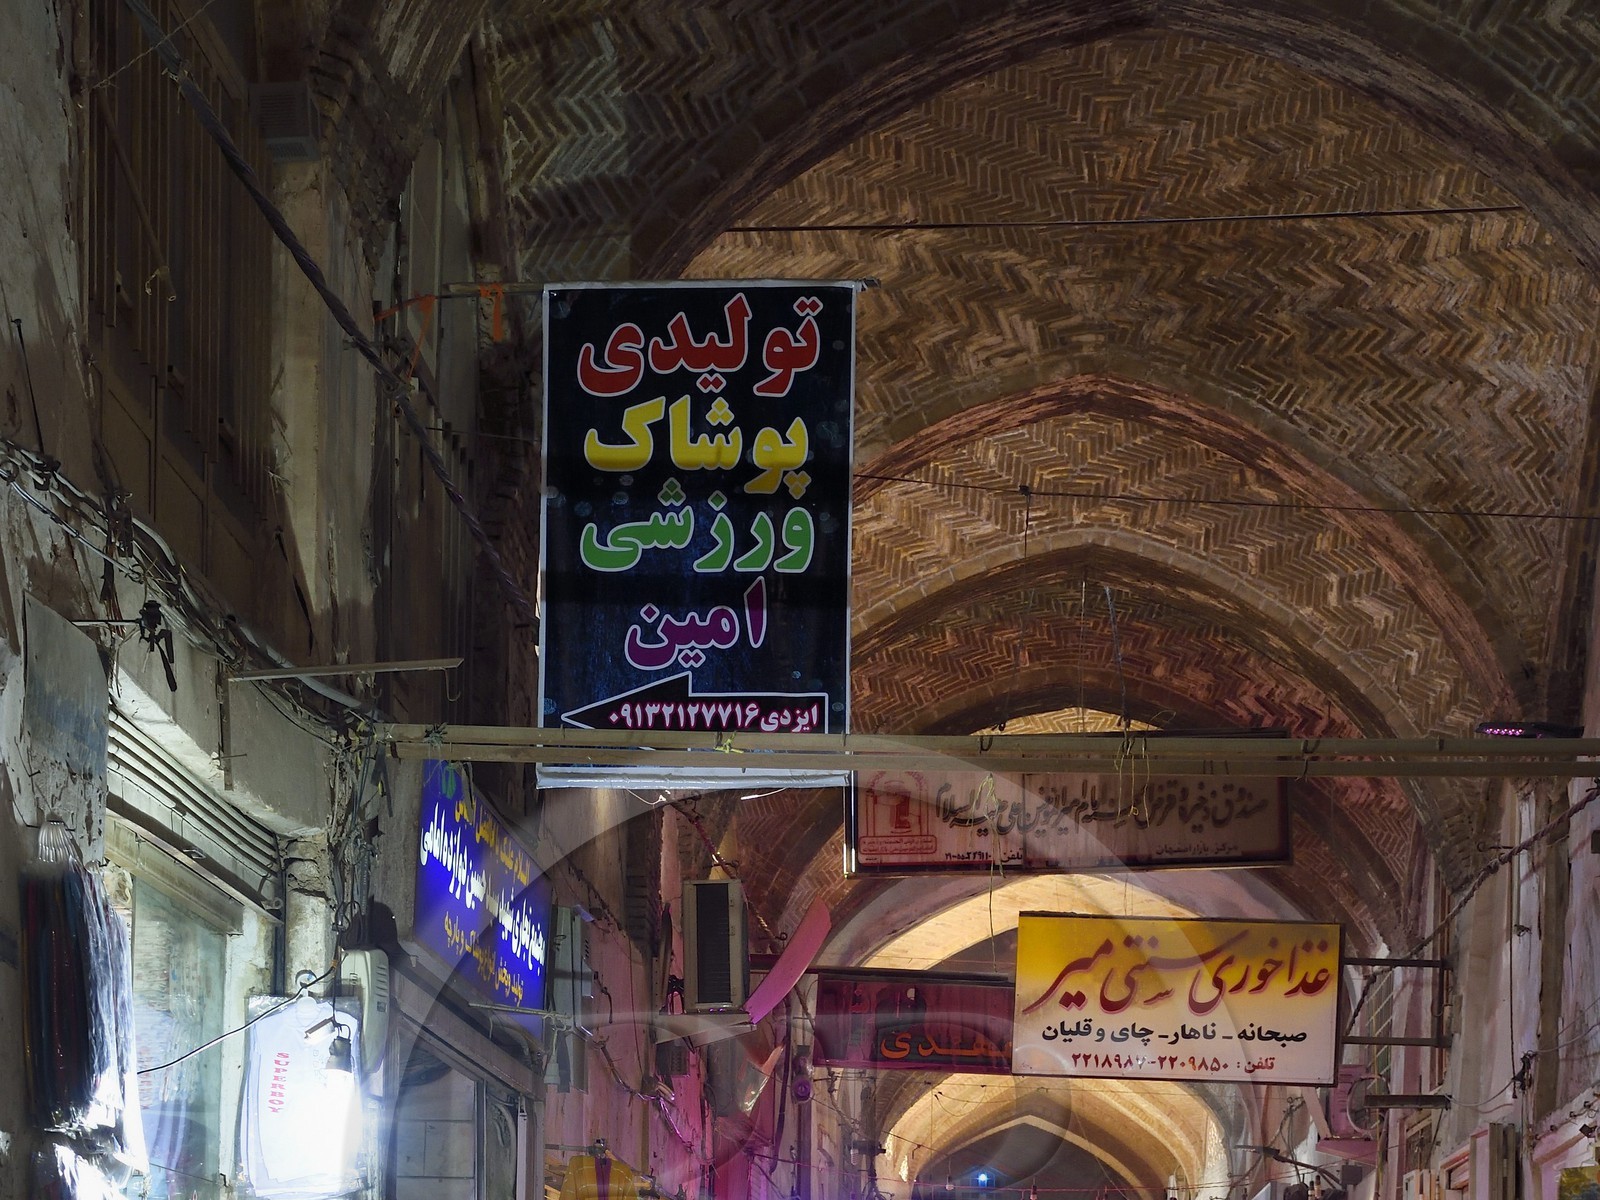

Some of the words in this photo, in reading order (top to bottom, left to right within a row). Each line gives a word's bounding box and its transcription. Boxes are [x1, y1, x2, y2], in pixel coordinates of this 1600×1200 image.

[577, 292, 824, 398] تولیدی
[584, 396, 811, 500] پوشاک
[580, 477, 815, 574] ورزشی
[624, 576, 768, 670] امین
[608, 702, 761, 729] ۰۹۱۳۲۱۲۷۷۱۶
[760, 703, 819, 733] ایزدی
[1041, 1018, 1095, 1044] قلیان
[1110, 1022, 1154, 1047] چای
[1168, 1021, 1216, 1045] ناهار
[1237, 1022, 1307, 1048] صبحانه
